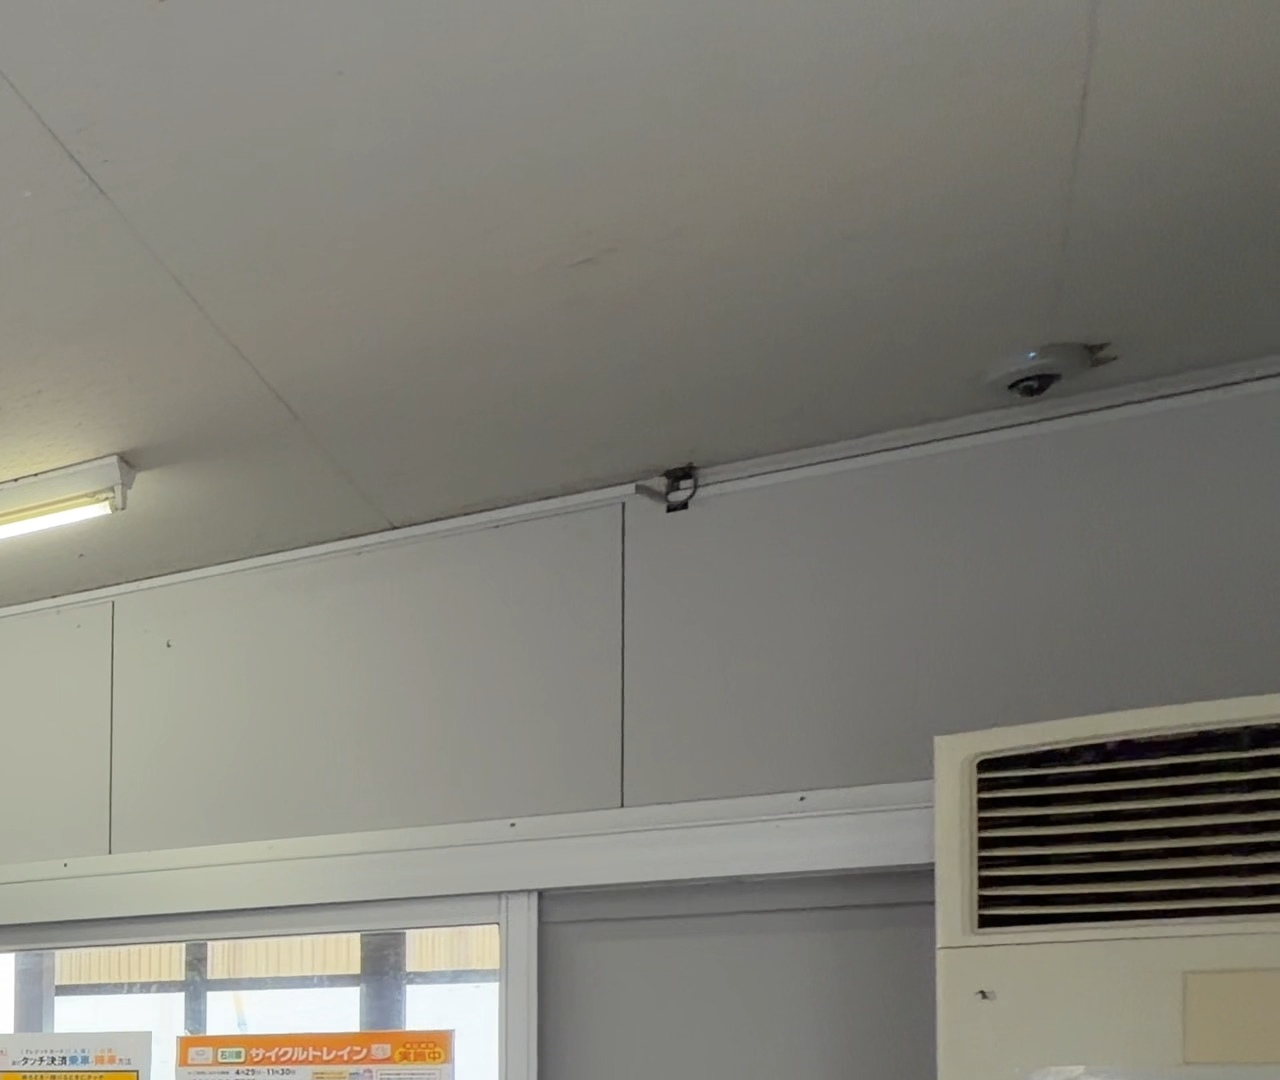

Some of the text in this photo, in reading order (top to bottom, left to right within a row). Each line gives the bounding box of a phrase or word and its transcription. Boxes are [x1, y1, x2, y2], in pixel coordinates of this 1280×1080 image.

[251, 1046, 369, 1063] サイクルトレイン
